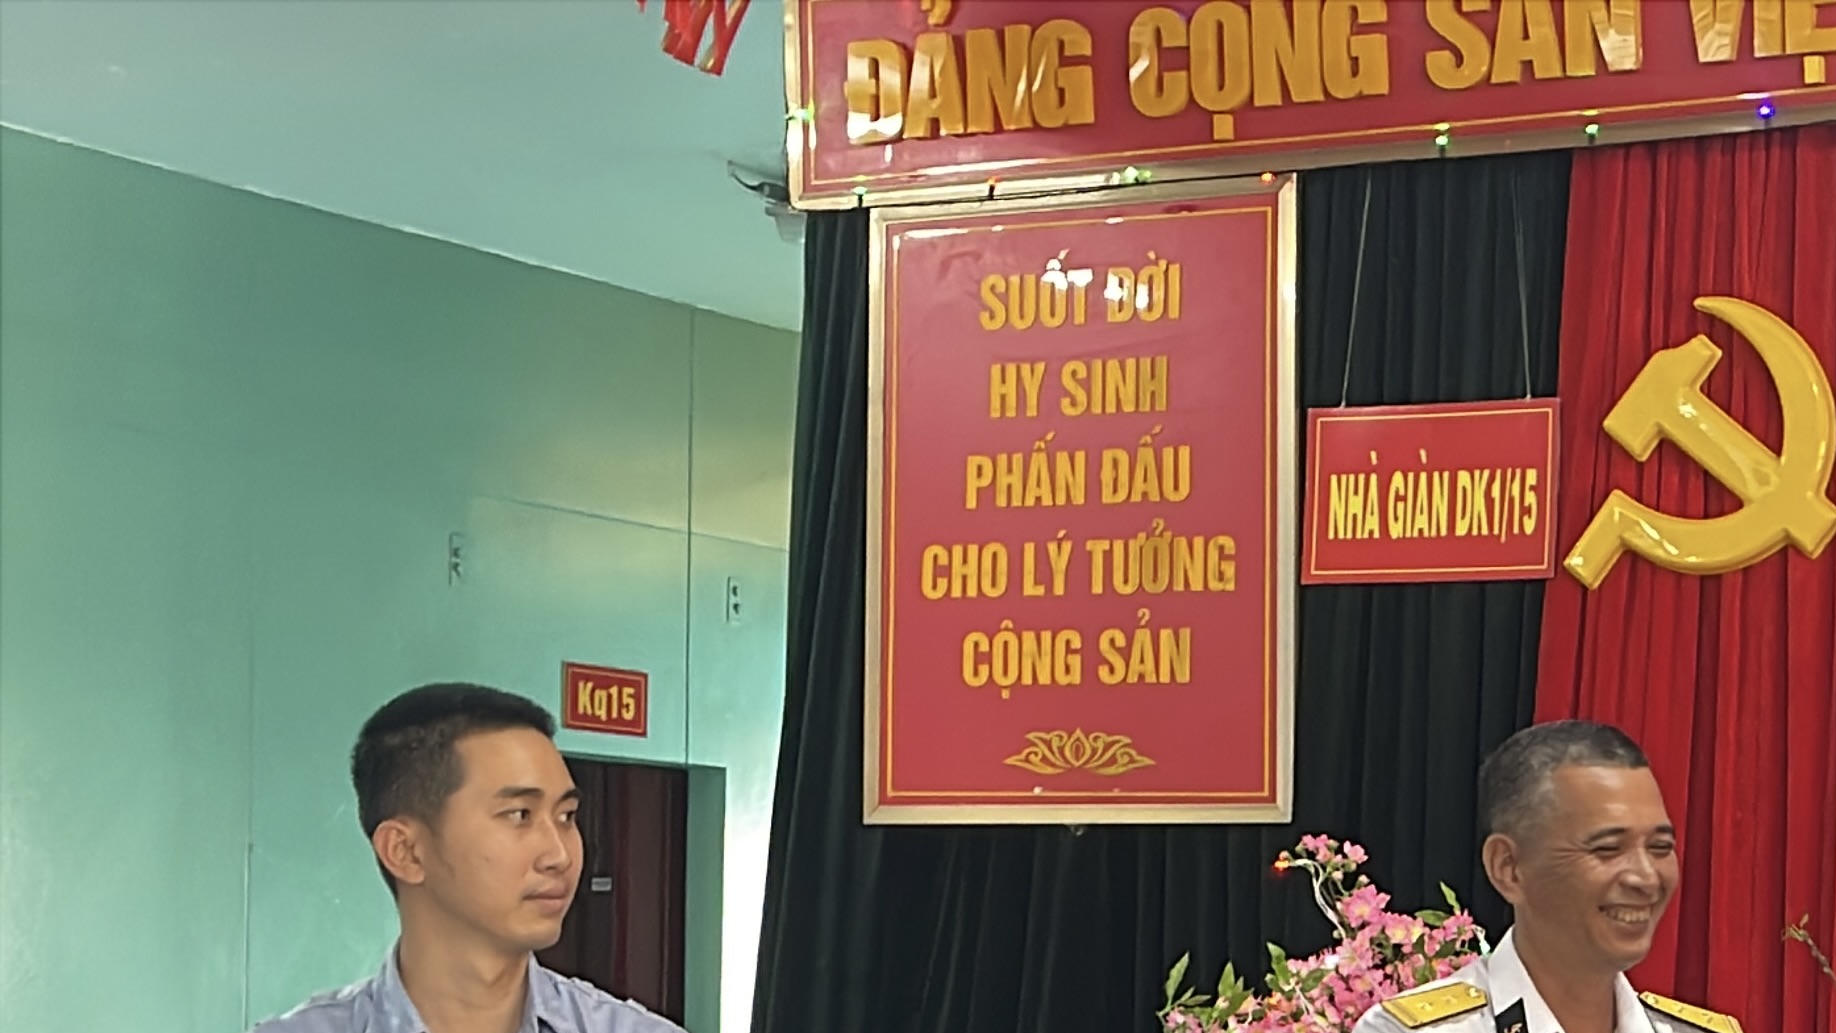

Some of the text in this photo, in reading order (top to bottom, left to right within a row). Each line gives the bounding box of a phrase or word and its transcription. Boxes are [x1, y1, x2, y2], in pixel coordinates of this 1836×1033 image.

[979, 249, 1092, 331] SUỐT
[989, 355, 1169, 419] HY SINH
[965, 426, 1192, 510] PHẤN ĐẤU
[1327, 448, 1539, 544] NHÀ GIÀN DK1/15
[921, 517, 1236, 599] CHO LÝ TƯỞNG
[961, 609, 1192, 700] CỘNG SẢN
